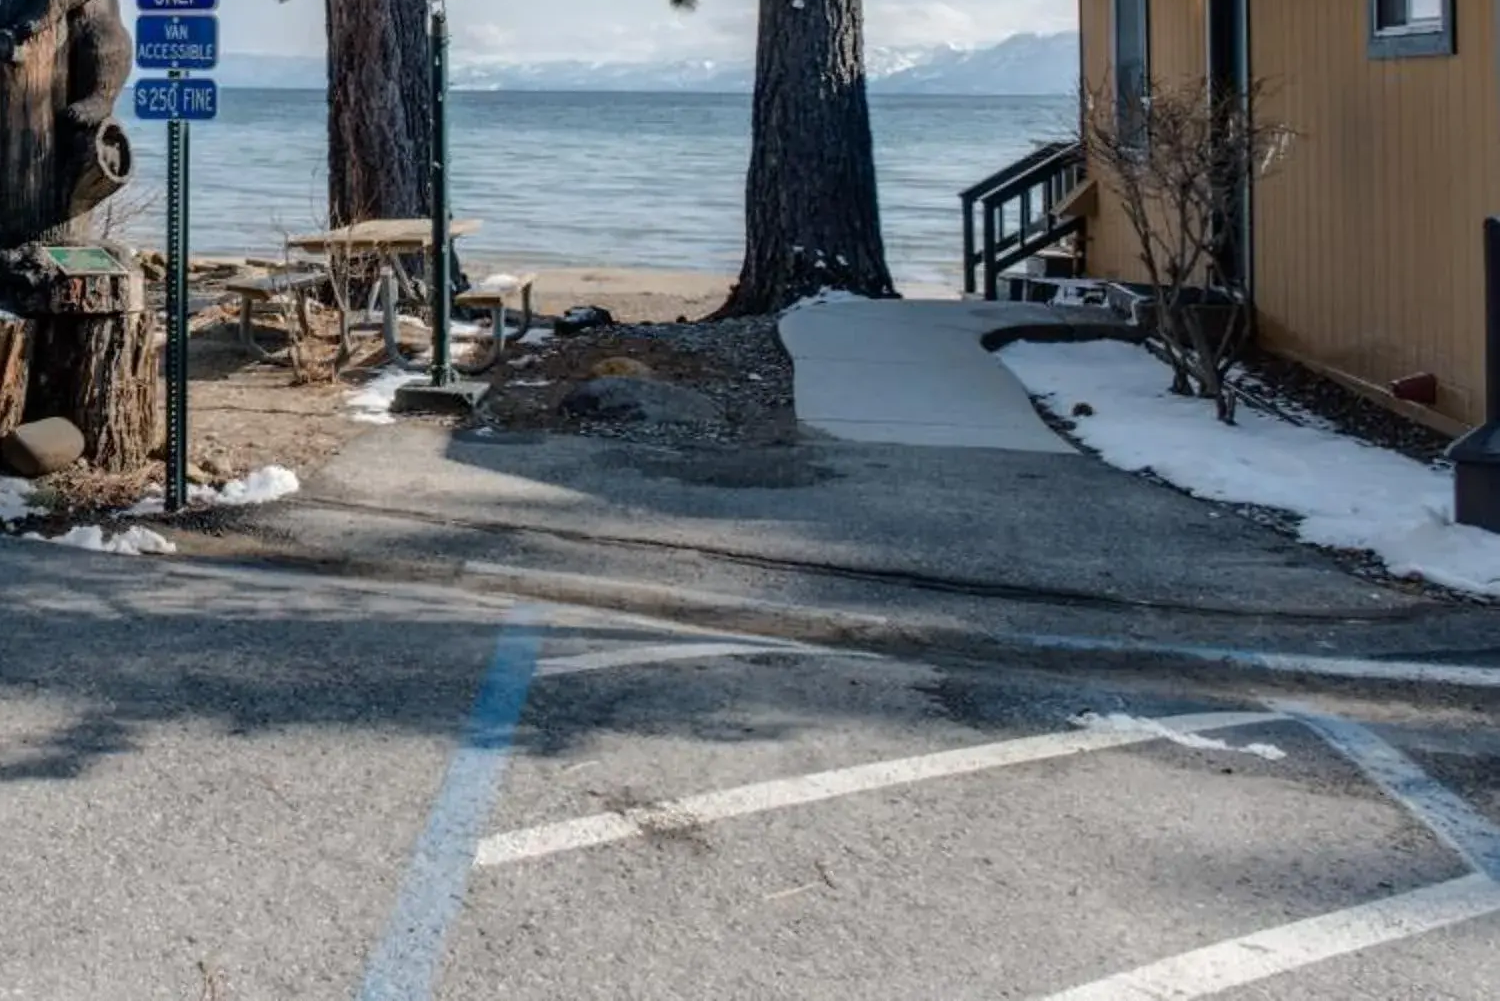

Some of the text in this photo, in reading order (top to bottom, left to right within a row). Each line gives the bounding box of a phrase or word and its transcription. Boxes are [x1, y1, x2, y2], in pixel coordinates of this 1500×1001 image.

[164, 24, 188, 39] VAN
[139, 43, 213, 60] ACCESSIBLE
[137, 87, 213, 111] $250 FINE
